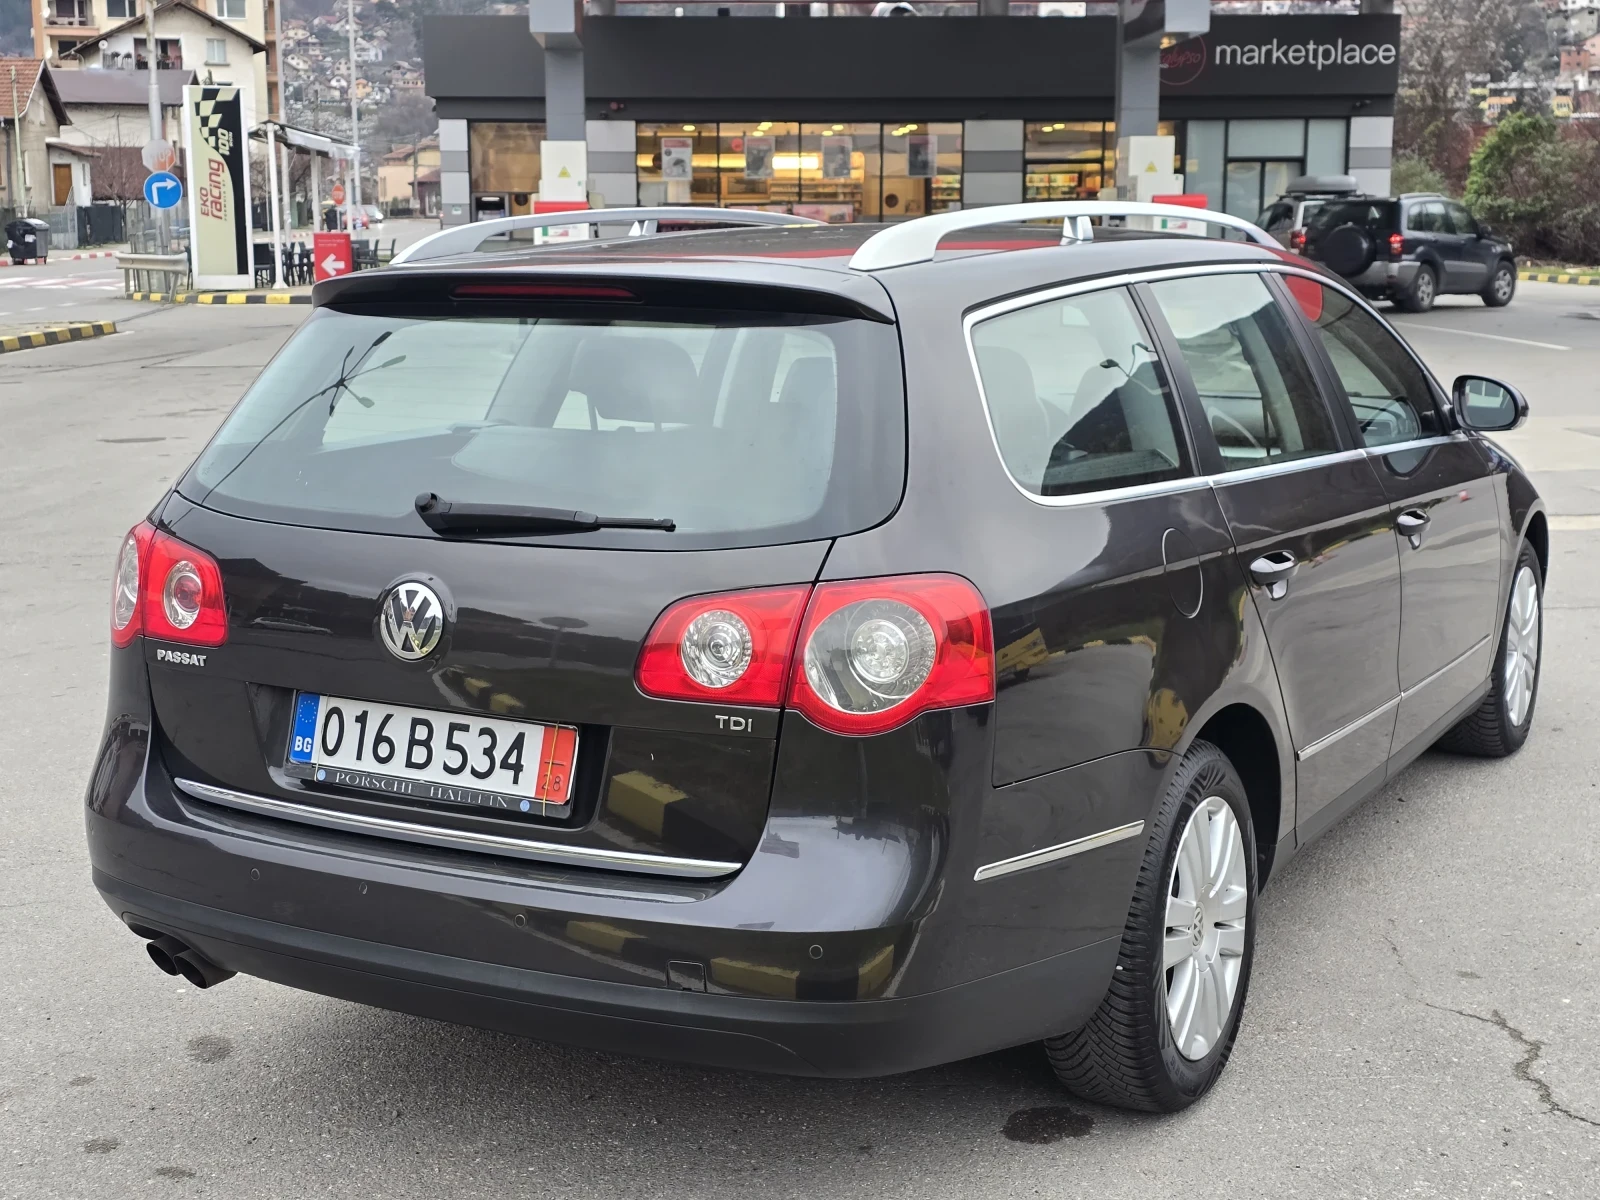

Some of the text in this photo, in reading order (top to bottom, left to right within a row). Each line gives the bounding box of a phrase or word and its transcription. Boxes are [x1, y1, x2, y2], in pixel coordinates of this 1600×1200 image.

[1215, 38, 1396, 71] marketplace
[217, 127, 230, 156] 100
[200, 186, 210, 217] EKO
[208, 158, 225, 220] racing
[156, 648, 207, 667] PASSAT
[714, 714, 753, 733] TDI
[294, 735, 313, 752] BG
[321, 706, 526, 785] 016B534
